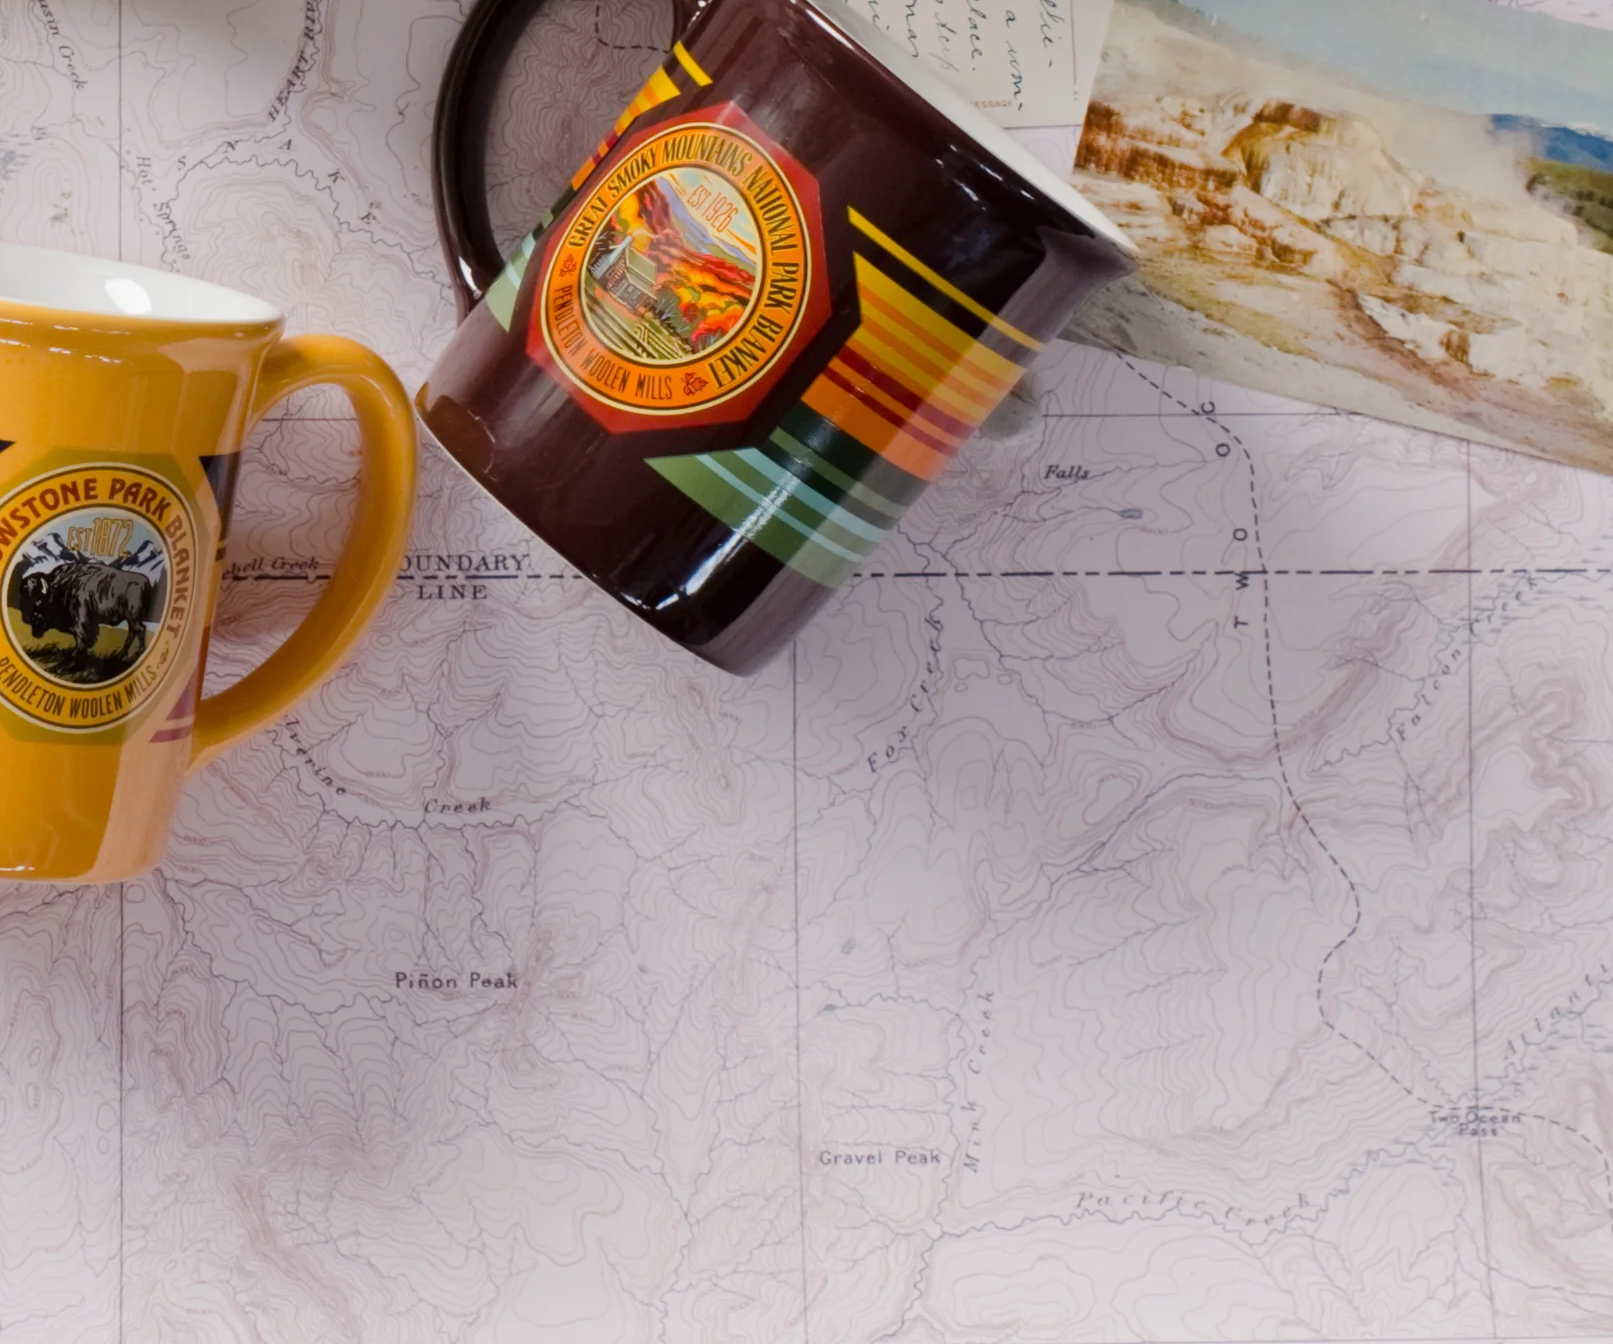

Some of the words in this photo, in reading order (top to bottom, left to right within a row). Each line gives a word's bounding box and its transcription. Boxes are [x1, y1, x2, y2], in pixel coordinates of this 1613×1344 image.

[607, 147, 657, 199] SMOKY
[661, 133, 753, 178] MOUNTAINS
[567, 198, 609, 248] GREAT
[743, 165, 799, 257] NATIONAL
[763, 261, 800, 314] PARK
[553, 284, 589, 356] PENDLETON
[579, 347, 631, 393] WOOLEN
[635, 376, 674, 400] MILLS
[707, 313, 784, 390] BLANKET
[1043, 464, 1091, 481] Falls
[109, 477, 173, 522] PARK
[164, 515, 191, 639] BLANKET
[417, 585, 489, 600] LINE
[69, 695, 123, 719] WOOLEN
[125, 664, 157, 705] MILLS
[395, 972, 457, 989] Piñon
[470, 972, 518, 989] Peak
[819, 1150, 882, 1165] Gravel
[895, 1150, 940, 1164] Peak
